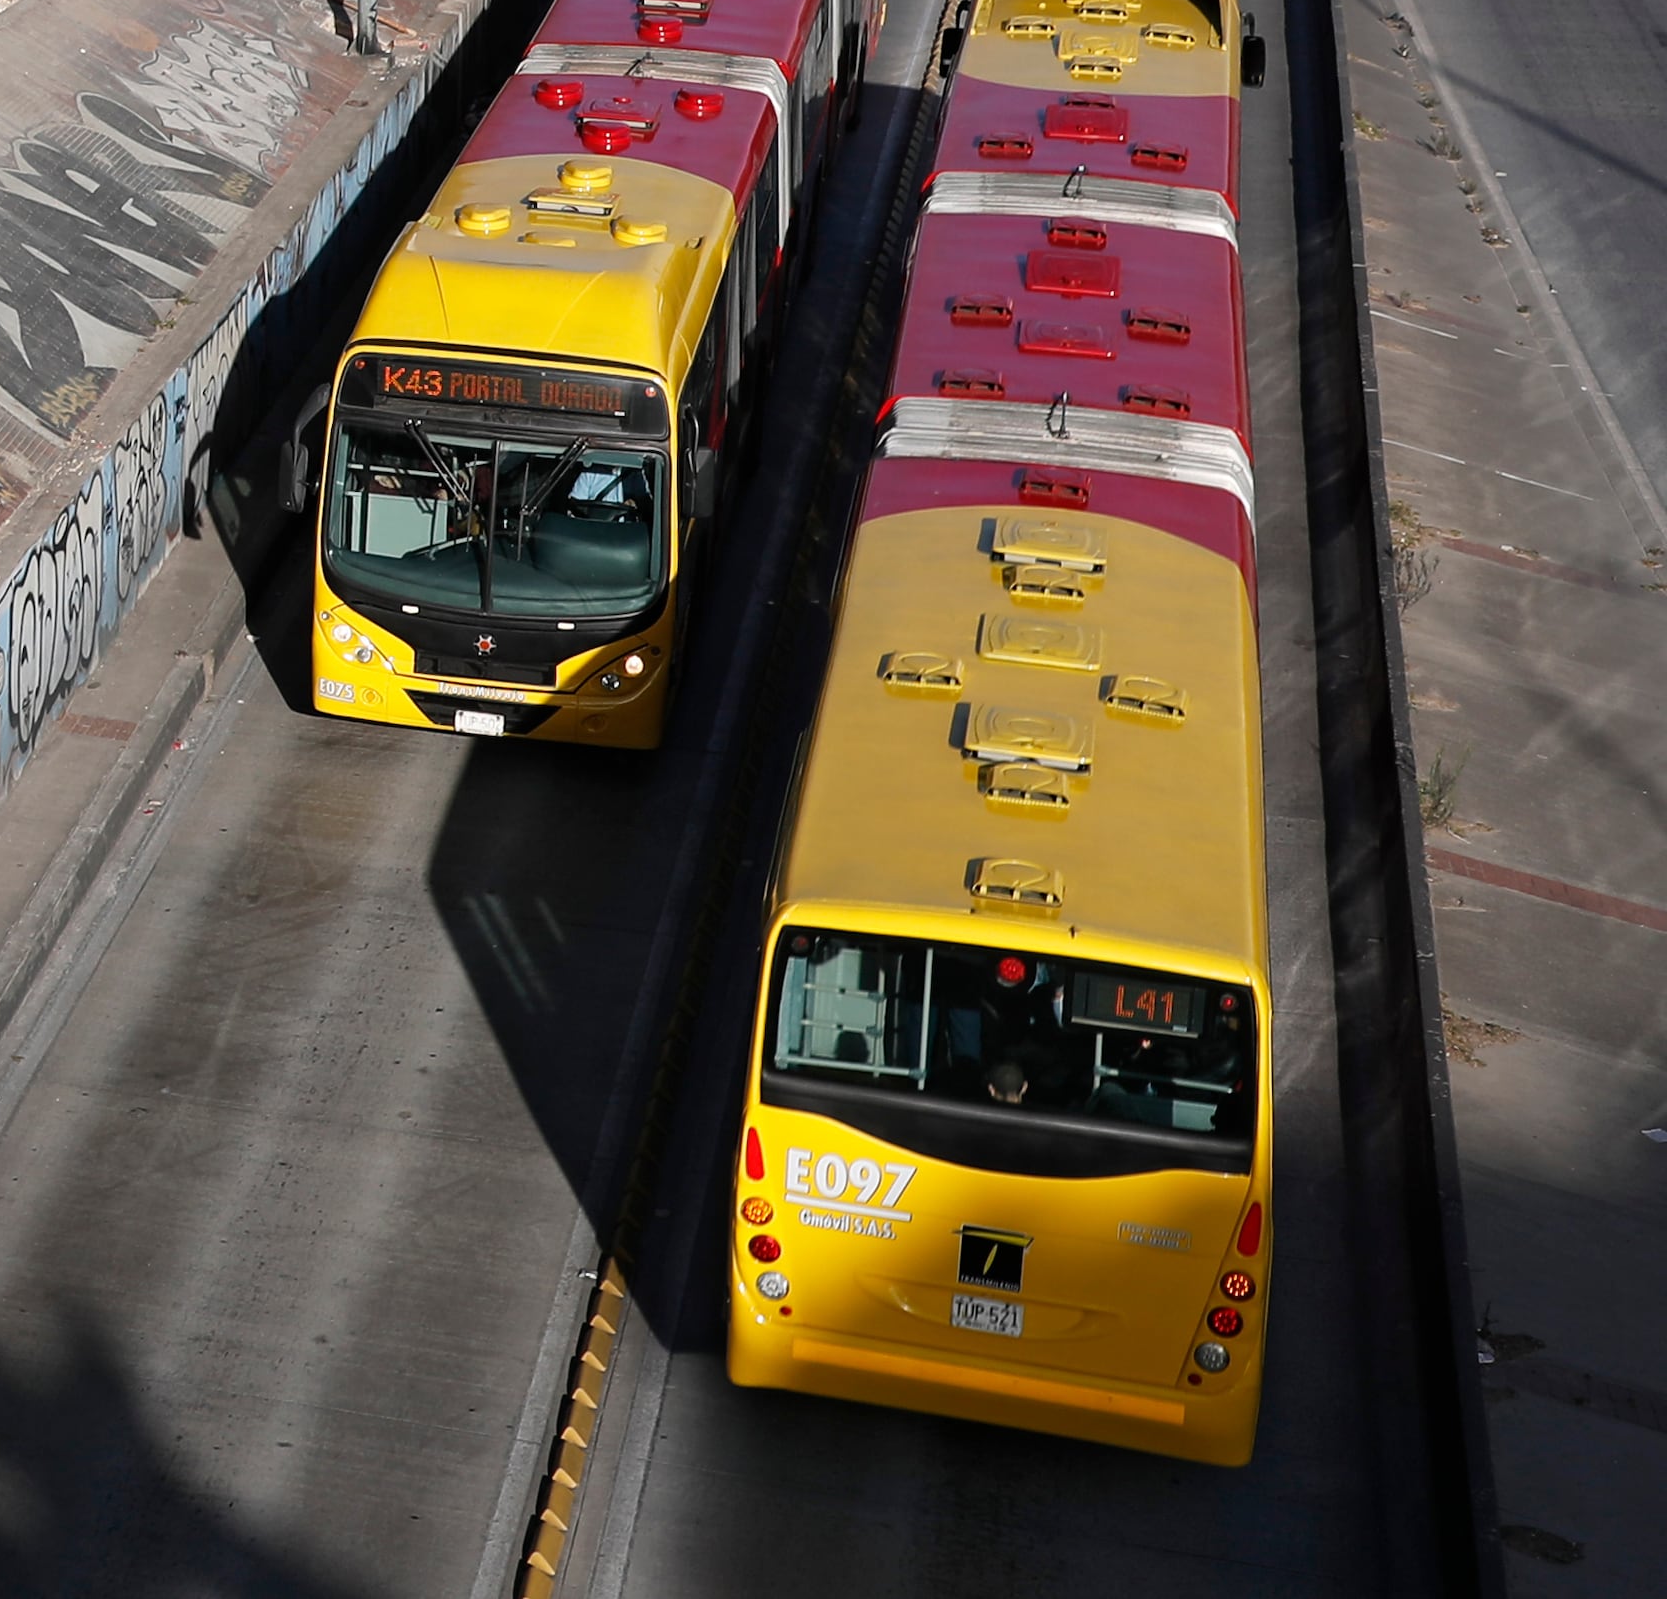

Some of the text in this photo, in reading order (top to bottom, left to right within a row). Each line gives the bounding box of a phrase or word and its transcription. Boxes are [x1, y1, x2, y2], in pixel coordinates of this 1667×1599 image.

[383, 366, 443, 397] K43
[449, 372, 528, 404] PORTAL
[319, 678, 354, 700] E075
[438, 681, 526, 702] TransMilenio
[1115, 984, 1174, 1024] L41
[786, 1146, 918, 1208] E097
[853, 1217, 897, 1240] S.A.S.
[955, 1299, 985, 1321] TUP
[989, 1305, 1019, 1329] 521
